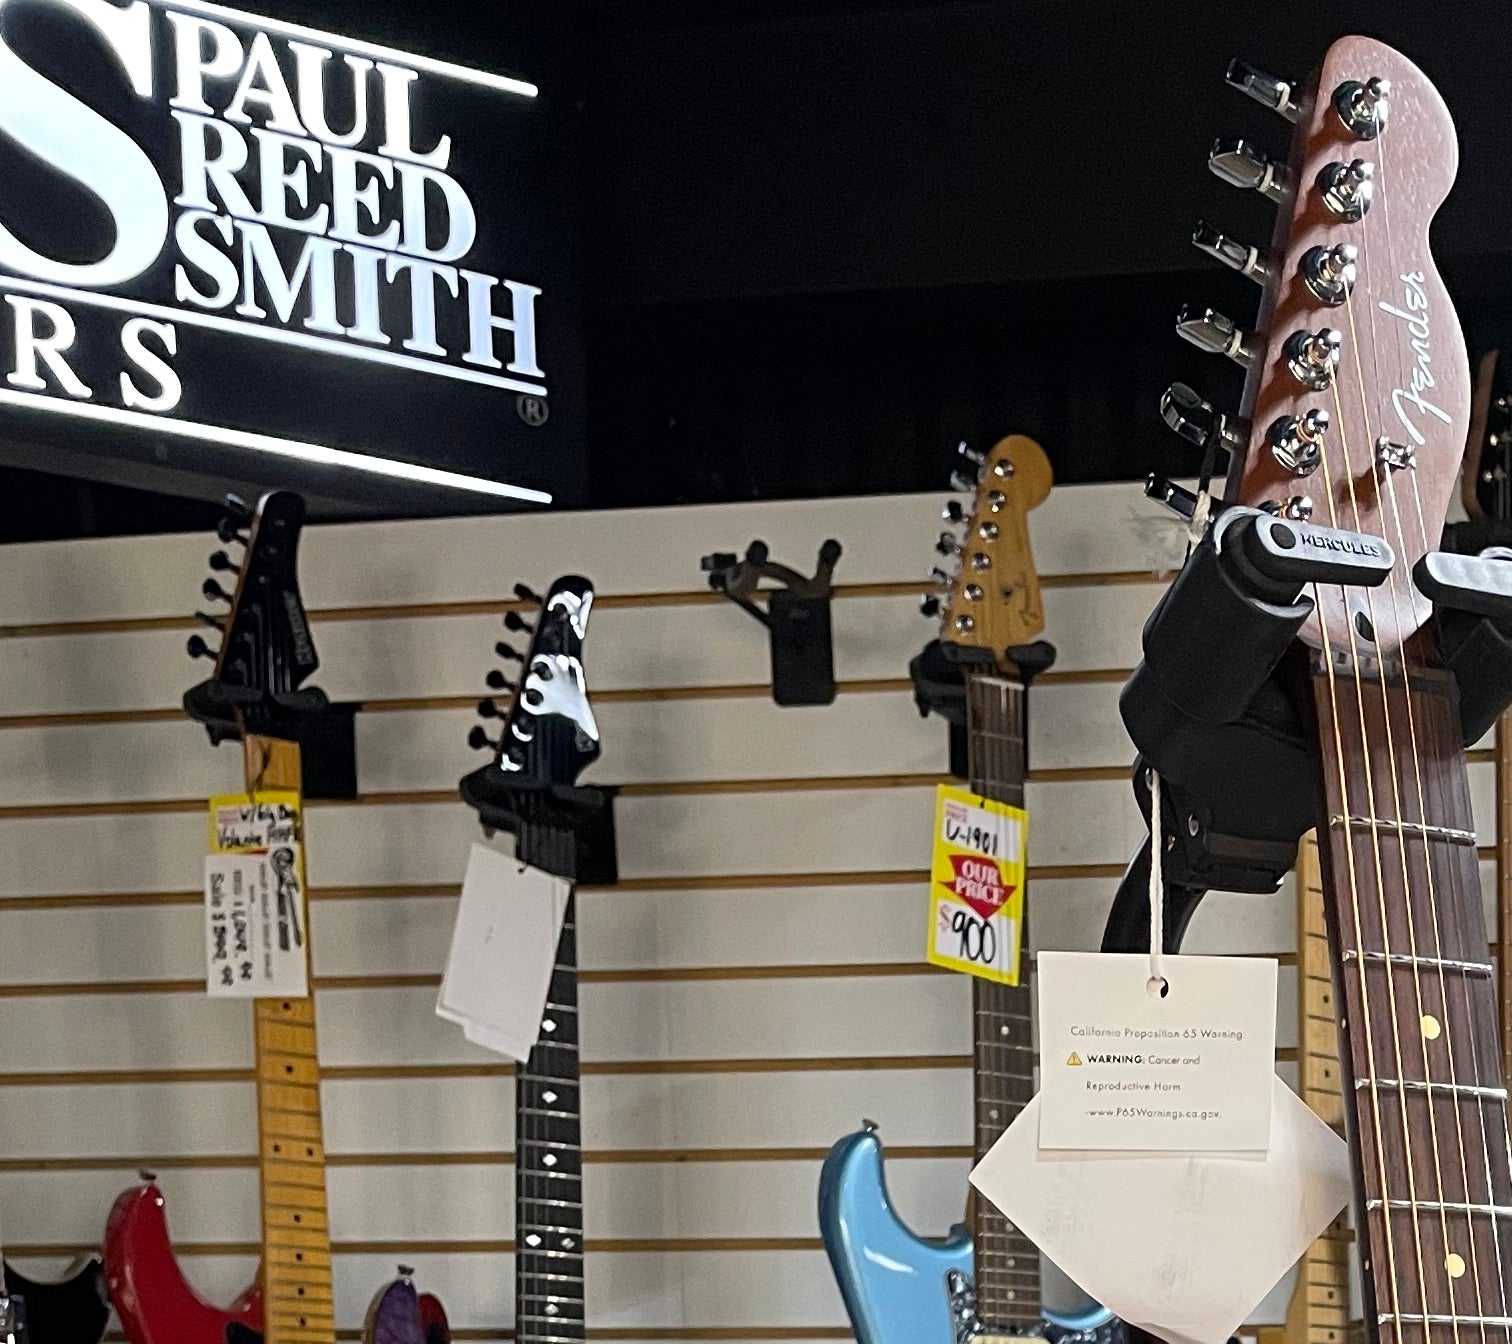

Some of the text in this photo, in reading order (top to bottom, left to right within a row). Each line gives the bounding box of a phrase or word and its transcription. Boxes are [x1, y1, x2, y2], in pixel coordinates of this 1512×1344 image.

[168, 8, 452, 171] PAUL
[171, 109, 477, 263] REED
[174, 207, 546, 379] SMITH
[1379, 271, 1453, 446] Fender
[1301, 533, 1381, 559] HERCULES
[961, 859, 999, 887] OUR
[955, 876, 1005, 906] PRICE
[1070, 1025, 1244, 1042] California Proposition 65 Warning
[1148, 1055, 1181, 1066] Cancer
[1182, 1055, 1201, 1066] and
[1086, 1080, 1181, 1093] Reproductive Harm
